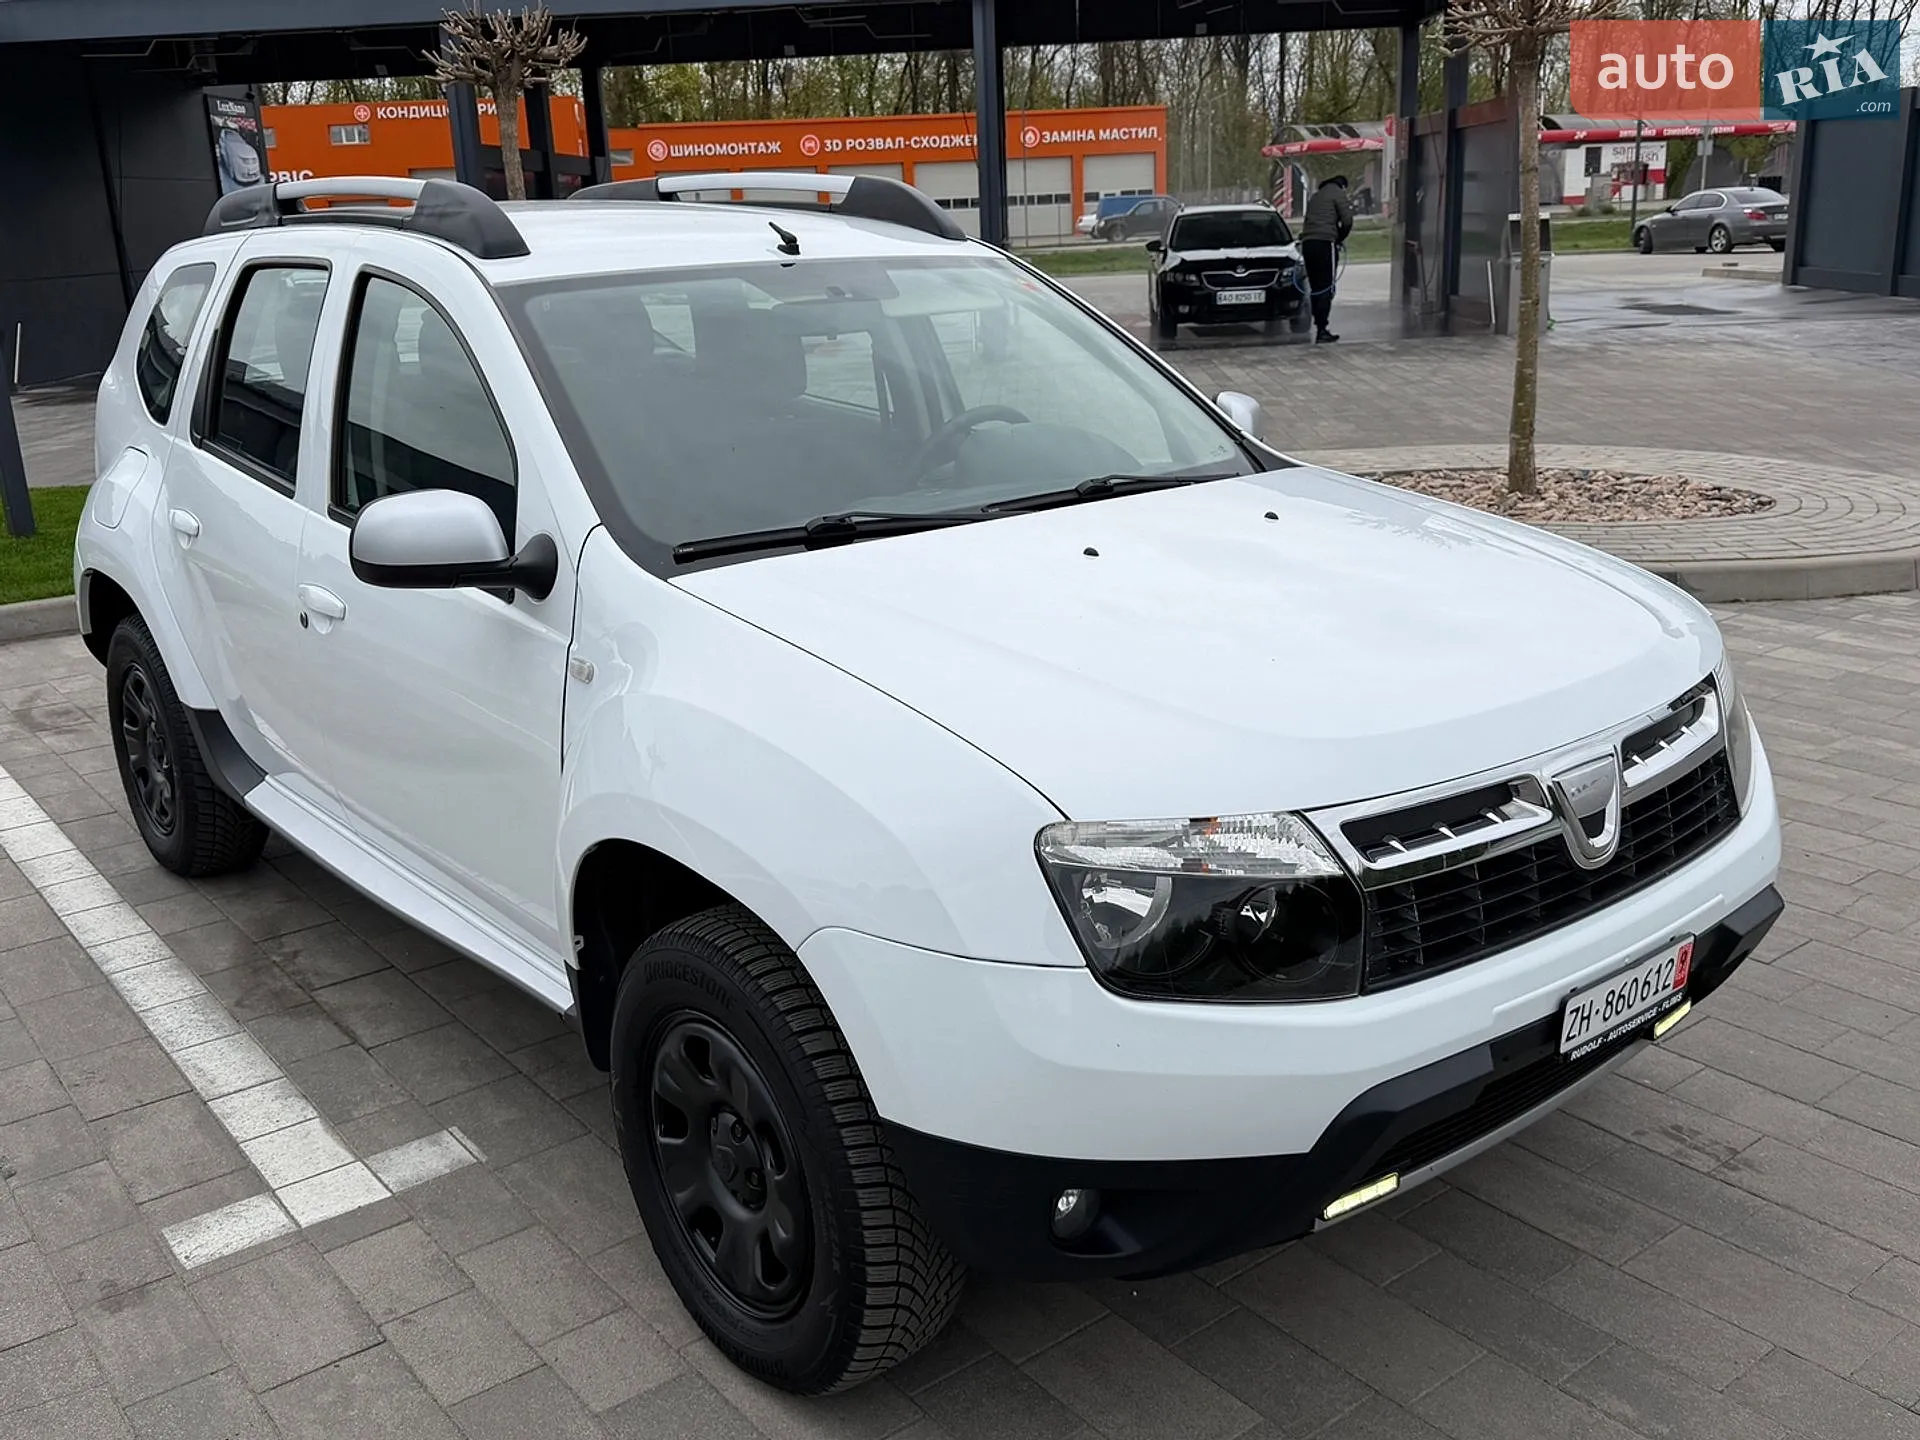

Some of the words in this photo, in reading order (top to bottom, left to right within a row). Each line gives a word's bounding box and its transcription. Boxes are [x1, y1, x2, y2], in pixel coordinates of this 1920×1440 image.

[824, 139, 842, 152] 3D
[846, 134, 977, 151] РОЗВАЛ-СХОДЖЕ
[1041, 129, 1096, 143] ЗАМІНА
[1099, 126, 1158, 141] МАСТИЛ
[669, 141, 782, 157] ШИНОМОНТАЖ
[1570, 1037, 1603, 1061] RUDOLF
